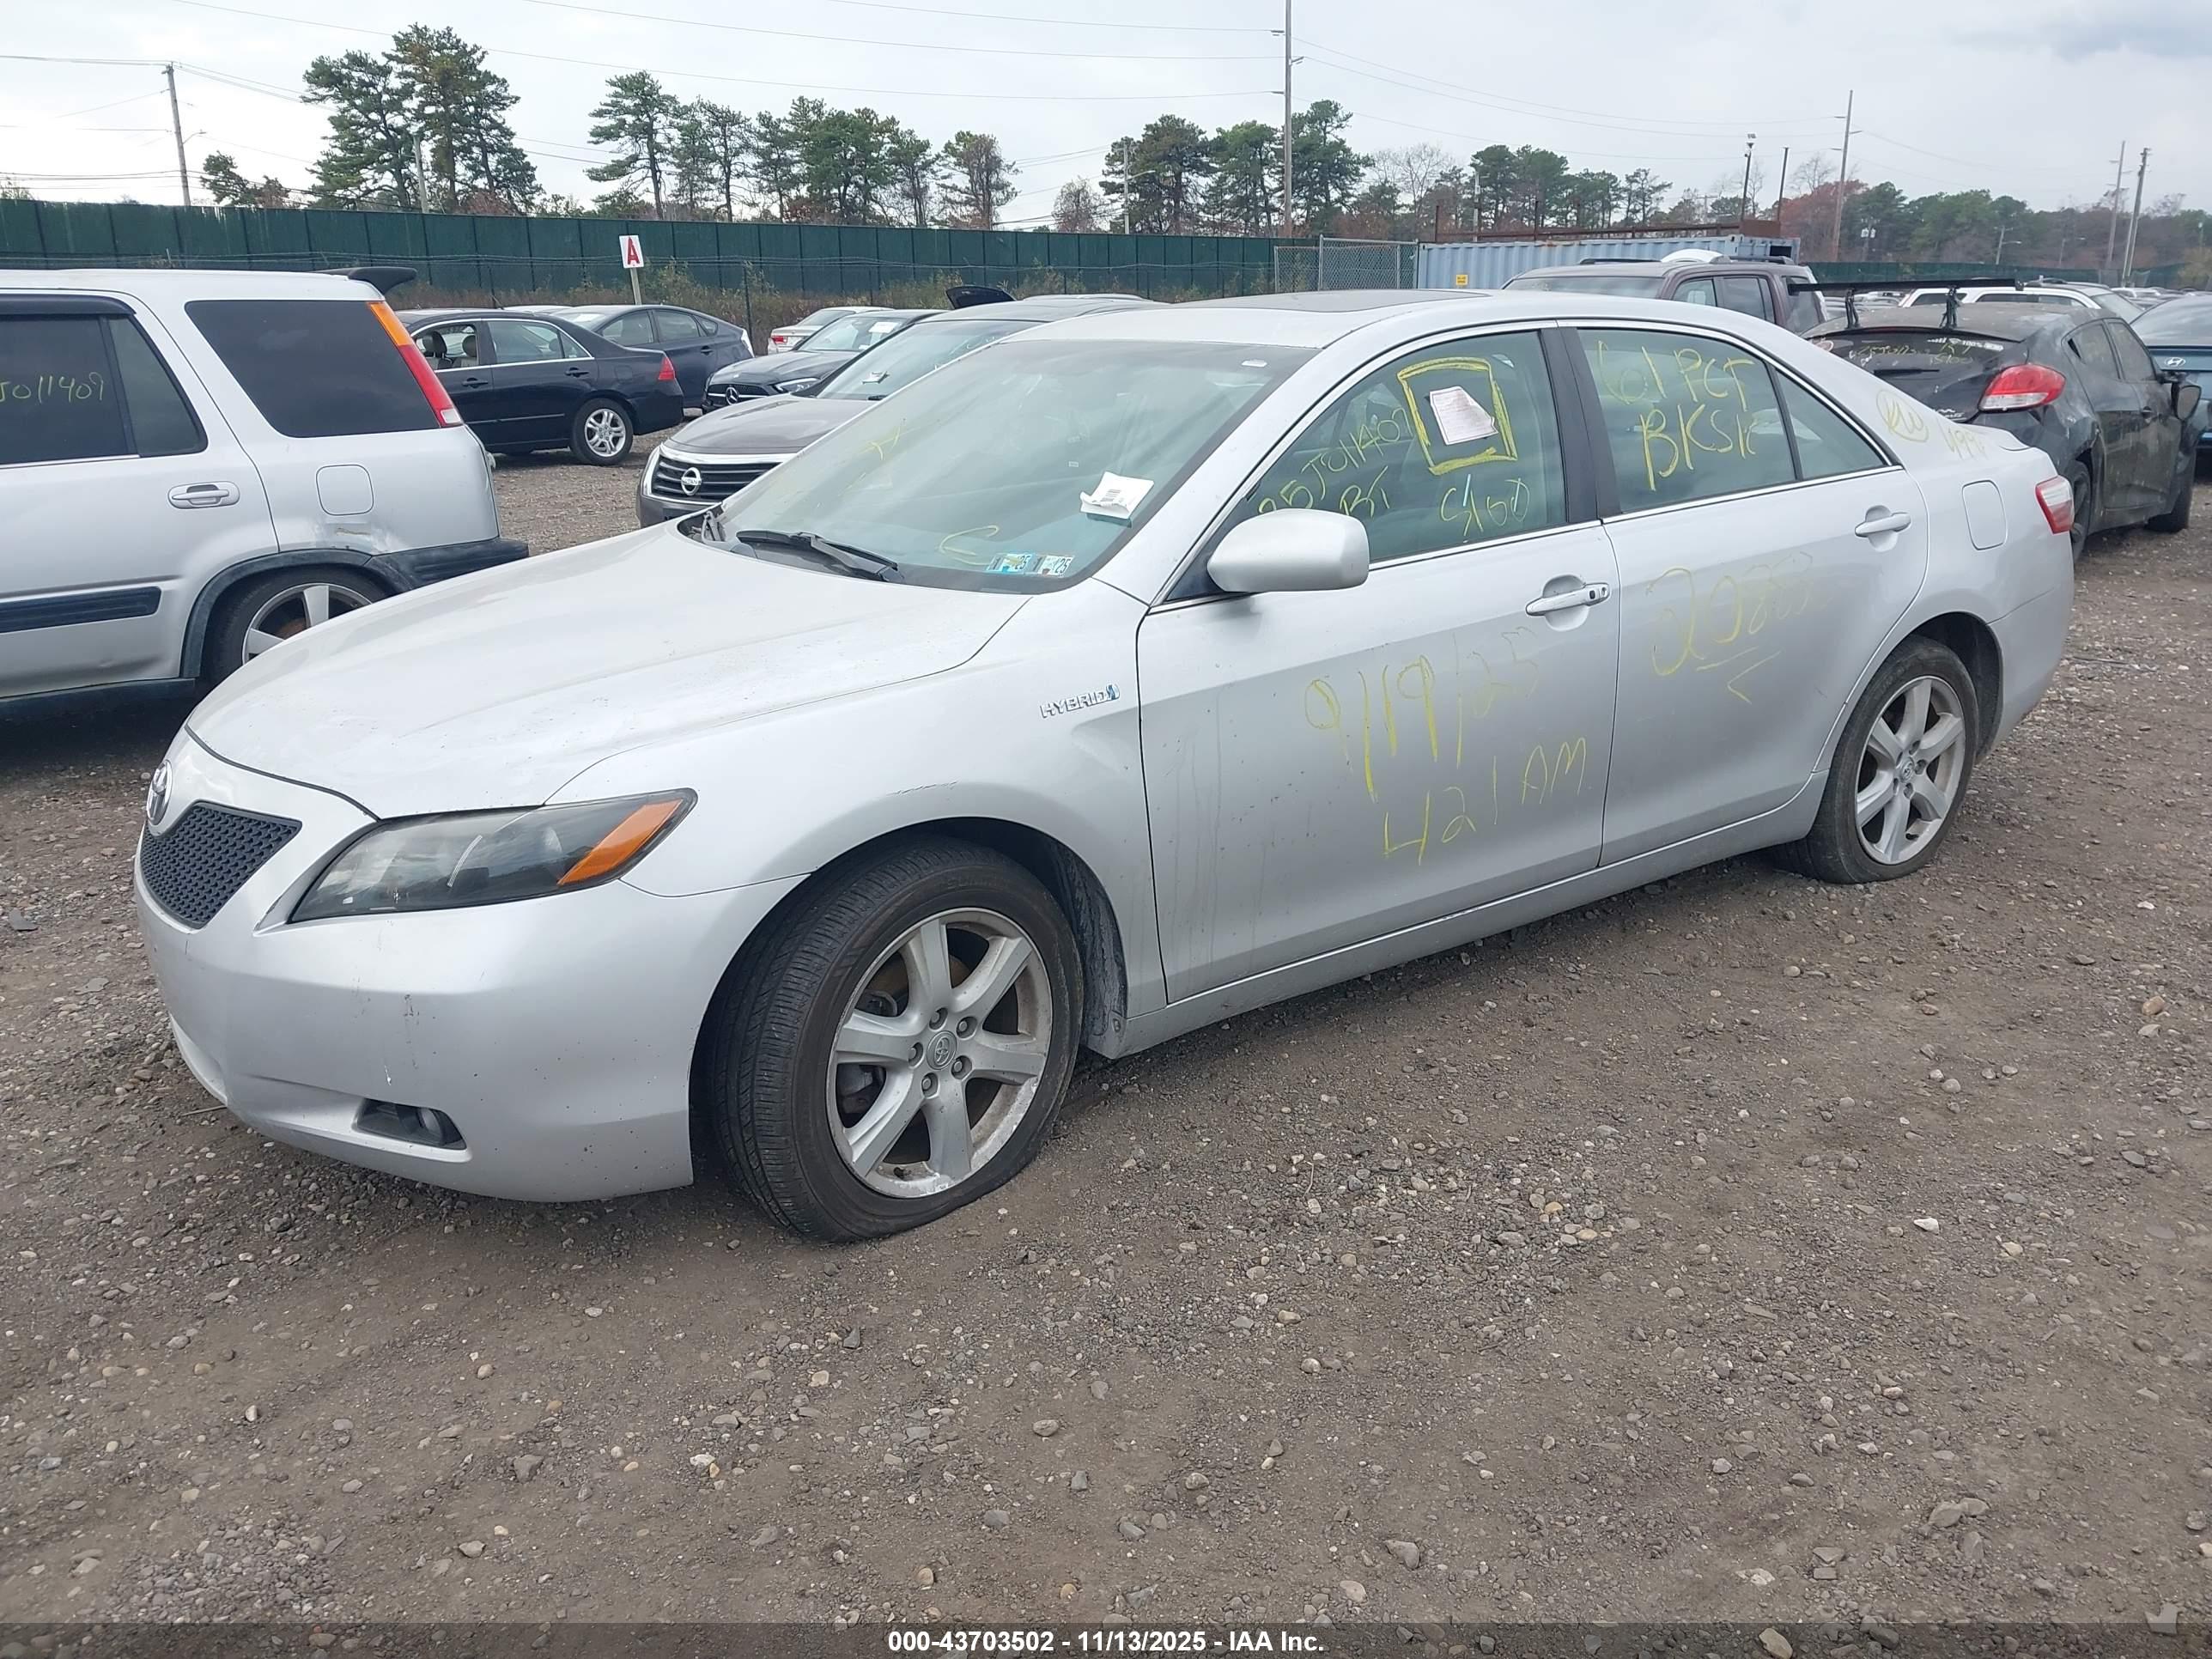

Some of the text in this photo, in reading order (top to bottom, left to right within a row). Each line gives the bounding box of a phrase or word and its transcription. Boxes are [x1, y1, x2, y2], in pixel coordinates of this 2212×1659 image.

[627, 236, 641, 264] A
[1039, 690, 1107, 718] HYBRID
[1521, 737, 1587, 805] AM
